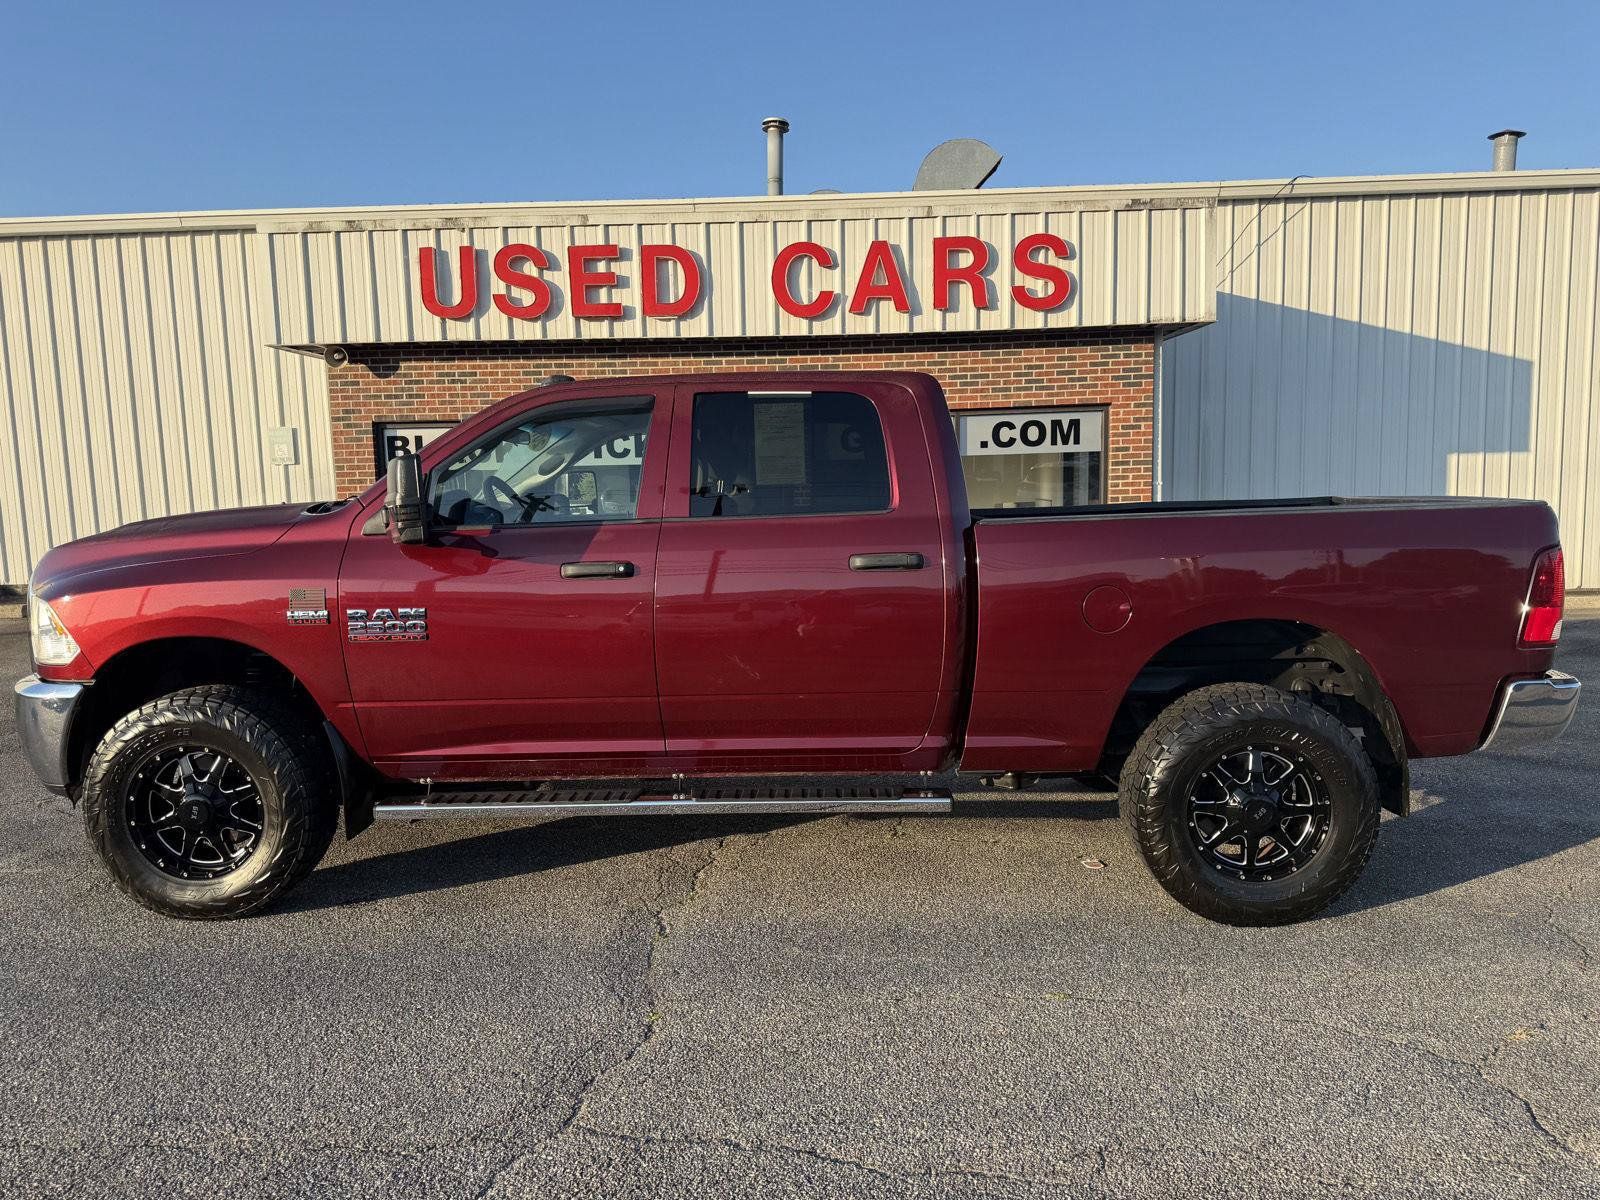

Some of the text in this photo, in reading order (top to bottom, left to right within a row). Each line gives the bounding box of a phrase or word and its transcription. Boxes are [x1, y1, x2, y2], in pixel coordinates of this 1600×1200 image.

[419, 233, 1072, 320] USED CARS
[347, 608, 426, 621] RAM
[347, 621, 426, 633] 2500
